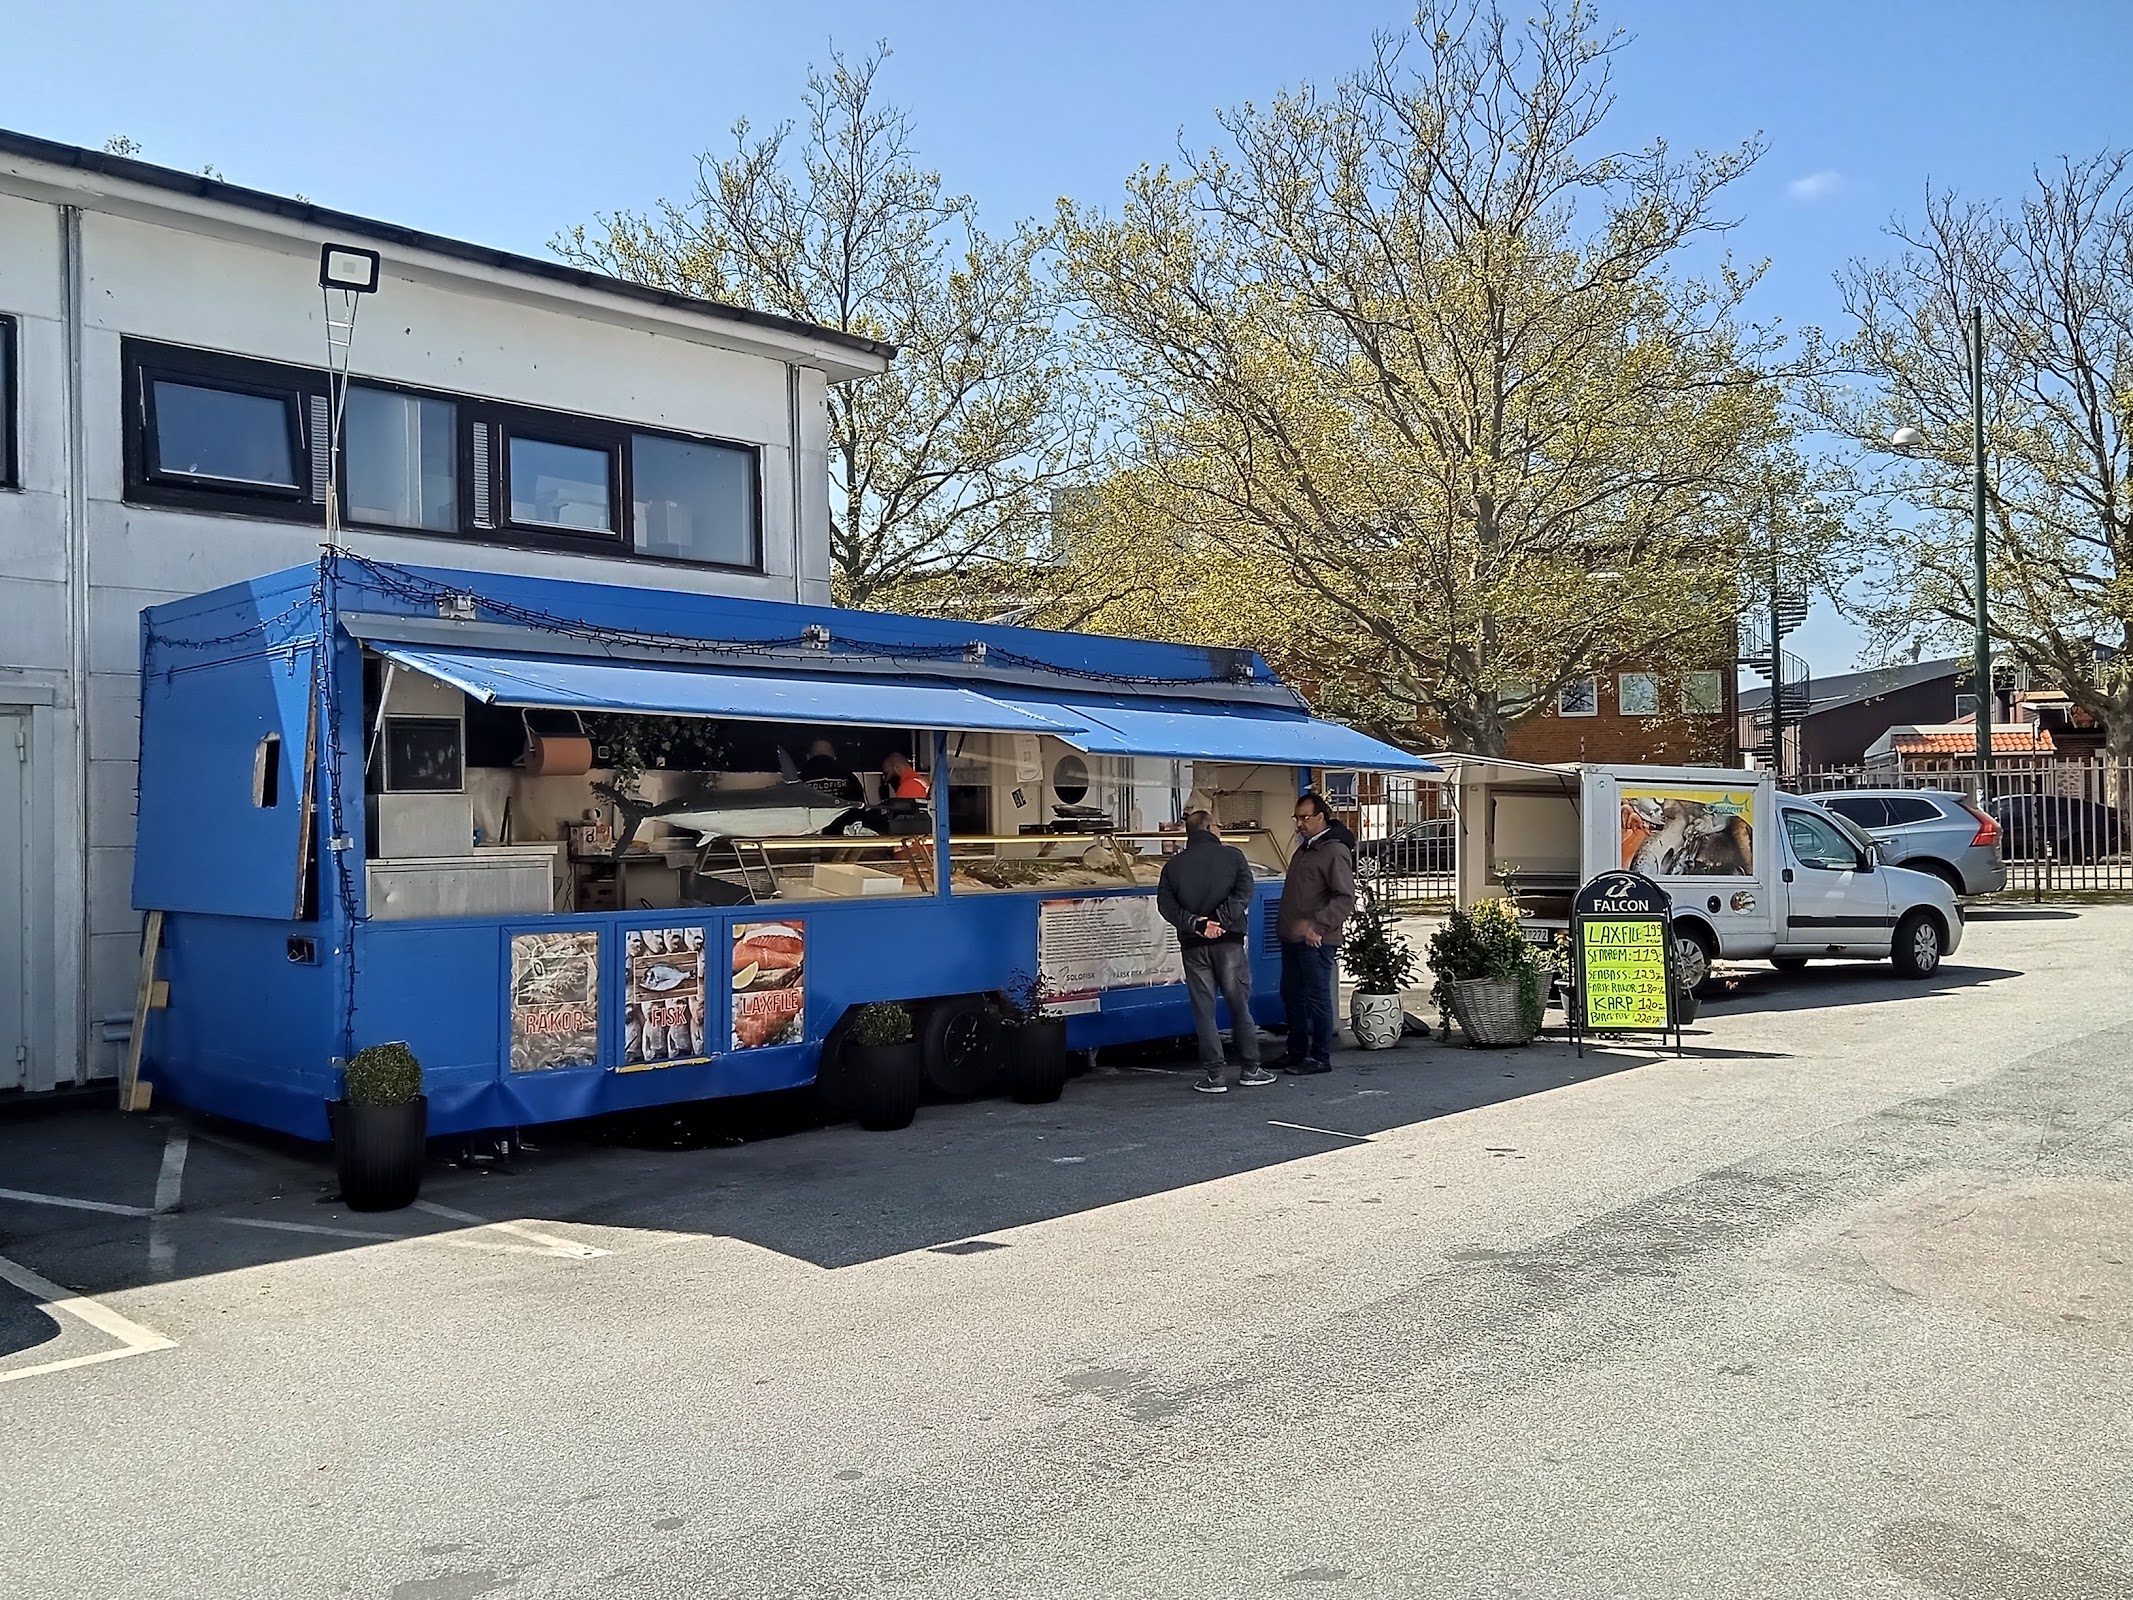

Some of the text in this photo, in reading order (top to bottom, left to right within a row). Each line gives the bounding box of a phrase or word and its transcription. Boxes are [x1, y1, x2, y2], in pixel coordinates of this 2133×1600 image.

[1593, 899, 1649, 912] FALCON
[1066, 972, 1095, 981] SOLOFISK
[742, 991, 800, 1016] LAXFILE
[1593, 996, 1633, 1012] KARP
[525, 1008, 584, 1035] RÄKOR
[651, 1004, 688, 1028] FISK
